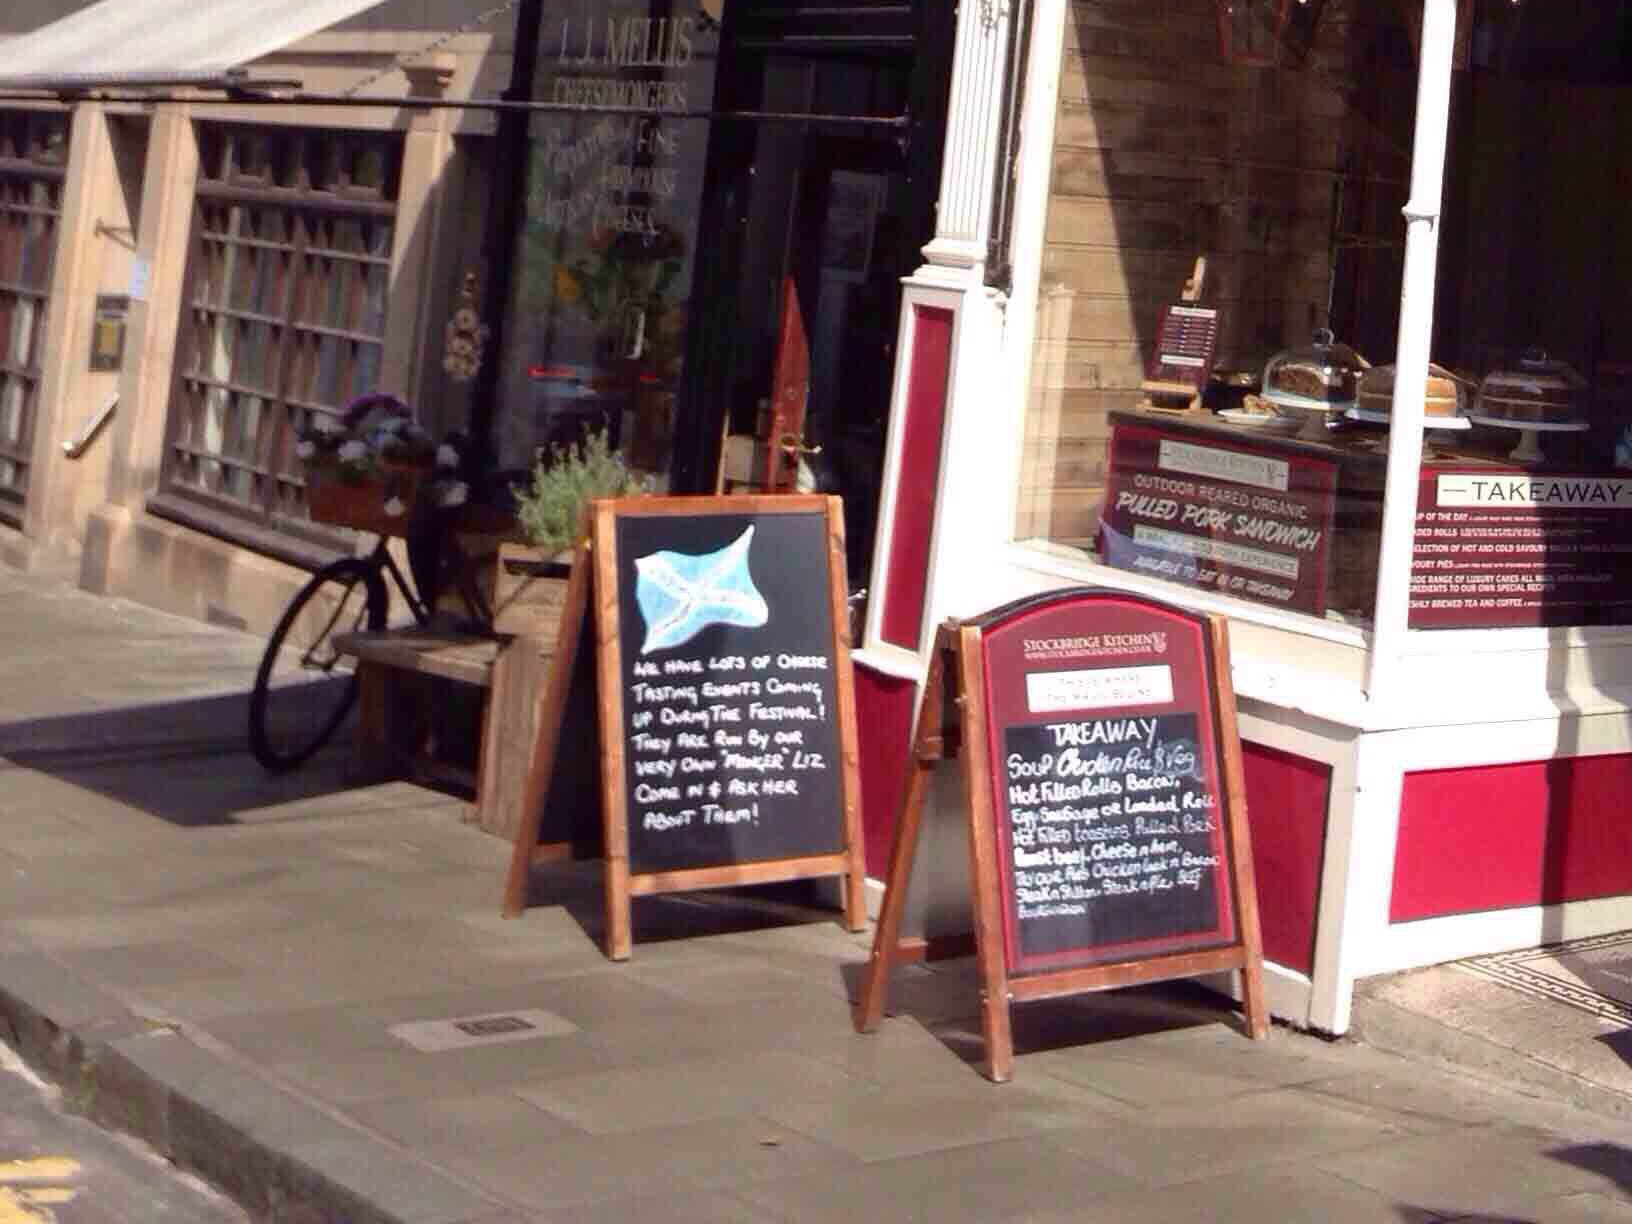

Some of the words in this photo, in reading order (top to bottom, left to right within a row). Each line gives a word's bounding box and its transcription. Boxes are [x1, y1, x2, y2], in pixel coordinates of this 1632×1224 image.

[1134, 474, 1195, 497] OUTDOOR
[1251, 495, 1309, 520] ORGANIC
[1471, 480, 1623, 505] TAKEAWAY
[1115, 490, 1179, 521] PULLED
[1181, 504, 1233, 531] PORK
[1233, 515, 1322, 552] SANDWICH
[1045, 717, 1158, 750] TAKEAWAY
